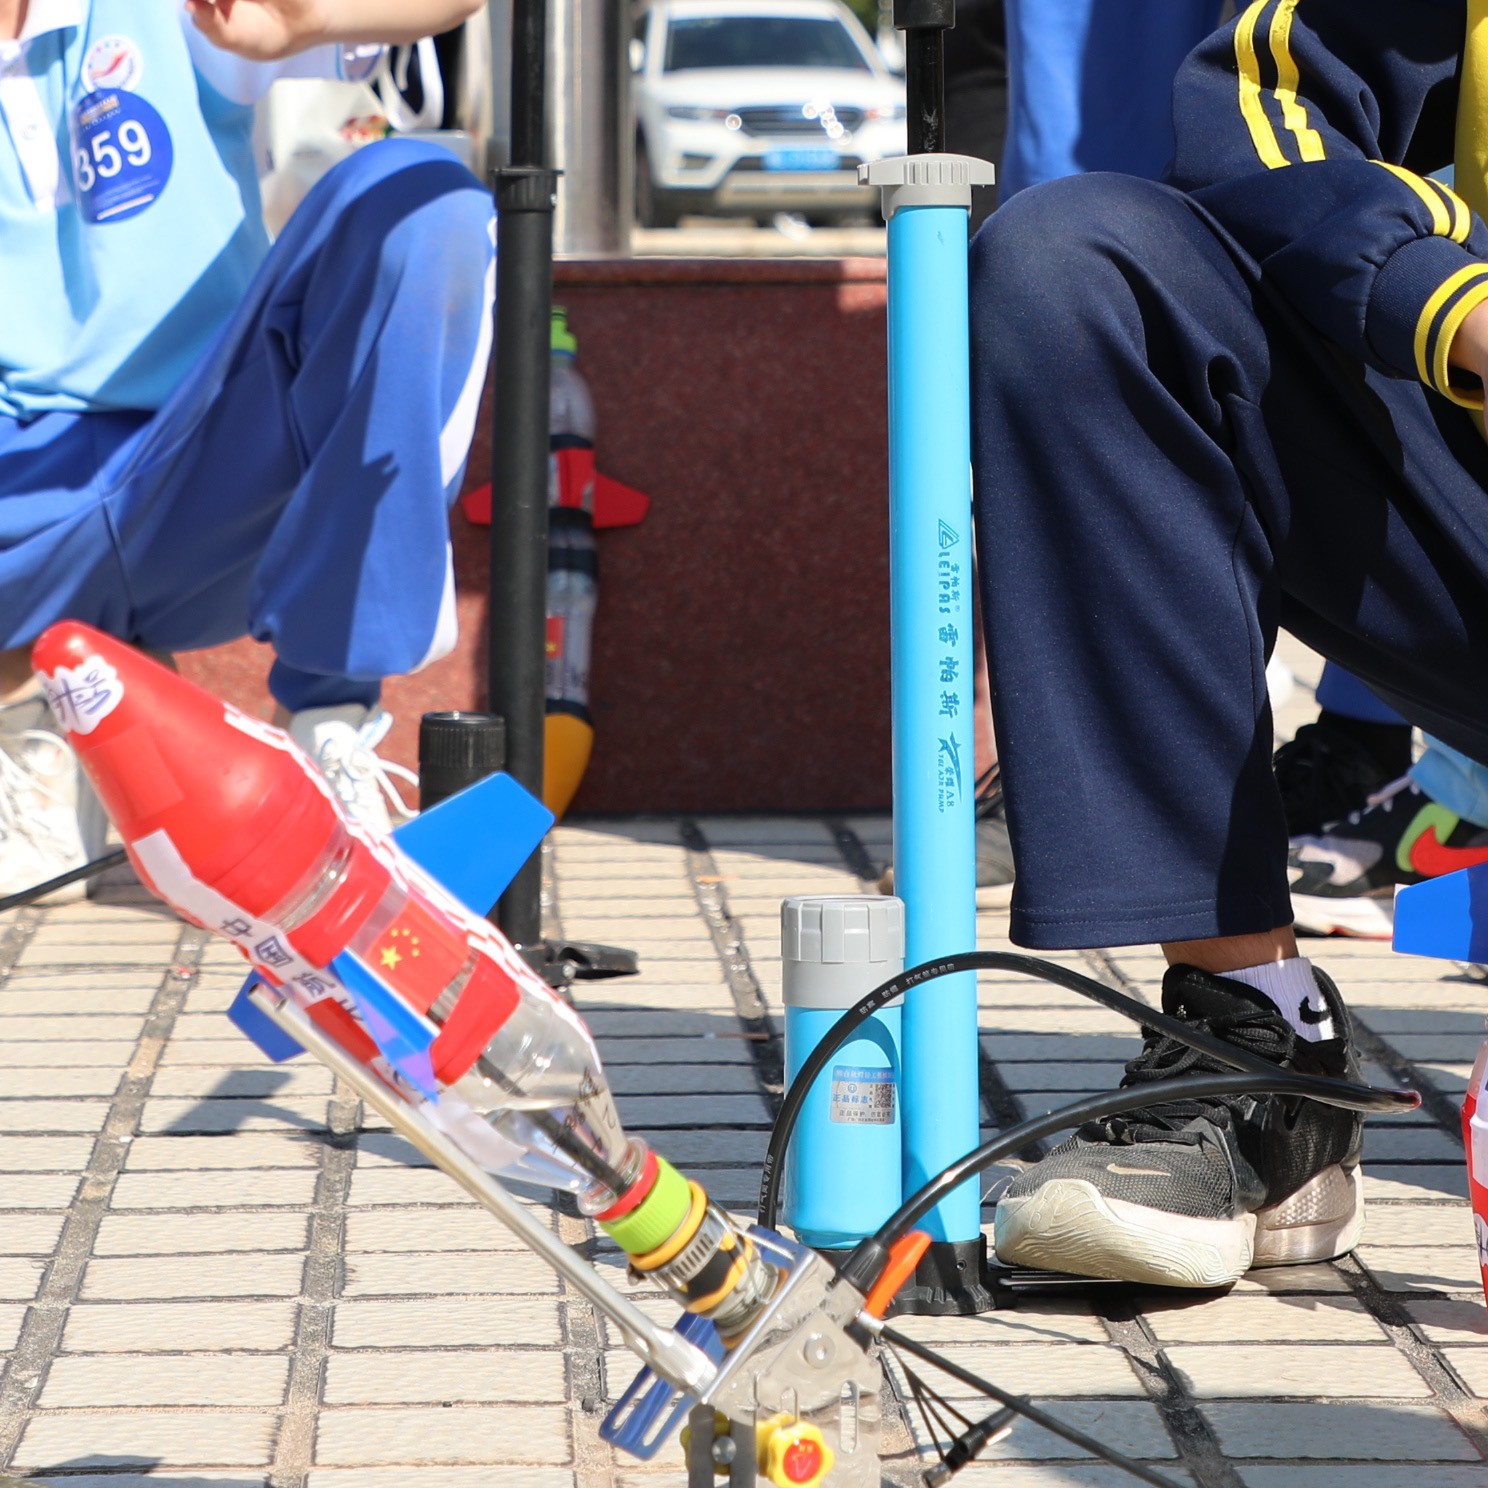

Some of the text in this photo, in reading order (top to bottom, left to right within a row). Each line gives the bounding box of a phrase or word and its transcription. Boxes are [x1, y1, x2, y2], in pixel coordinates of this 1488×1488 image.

[78, 119, 151, 192] 359
[938, 623, 959, 718] 雷帕斯
